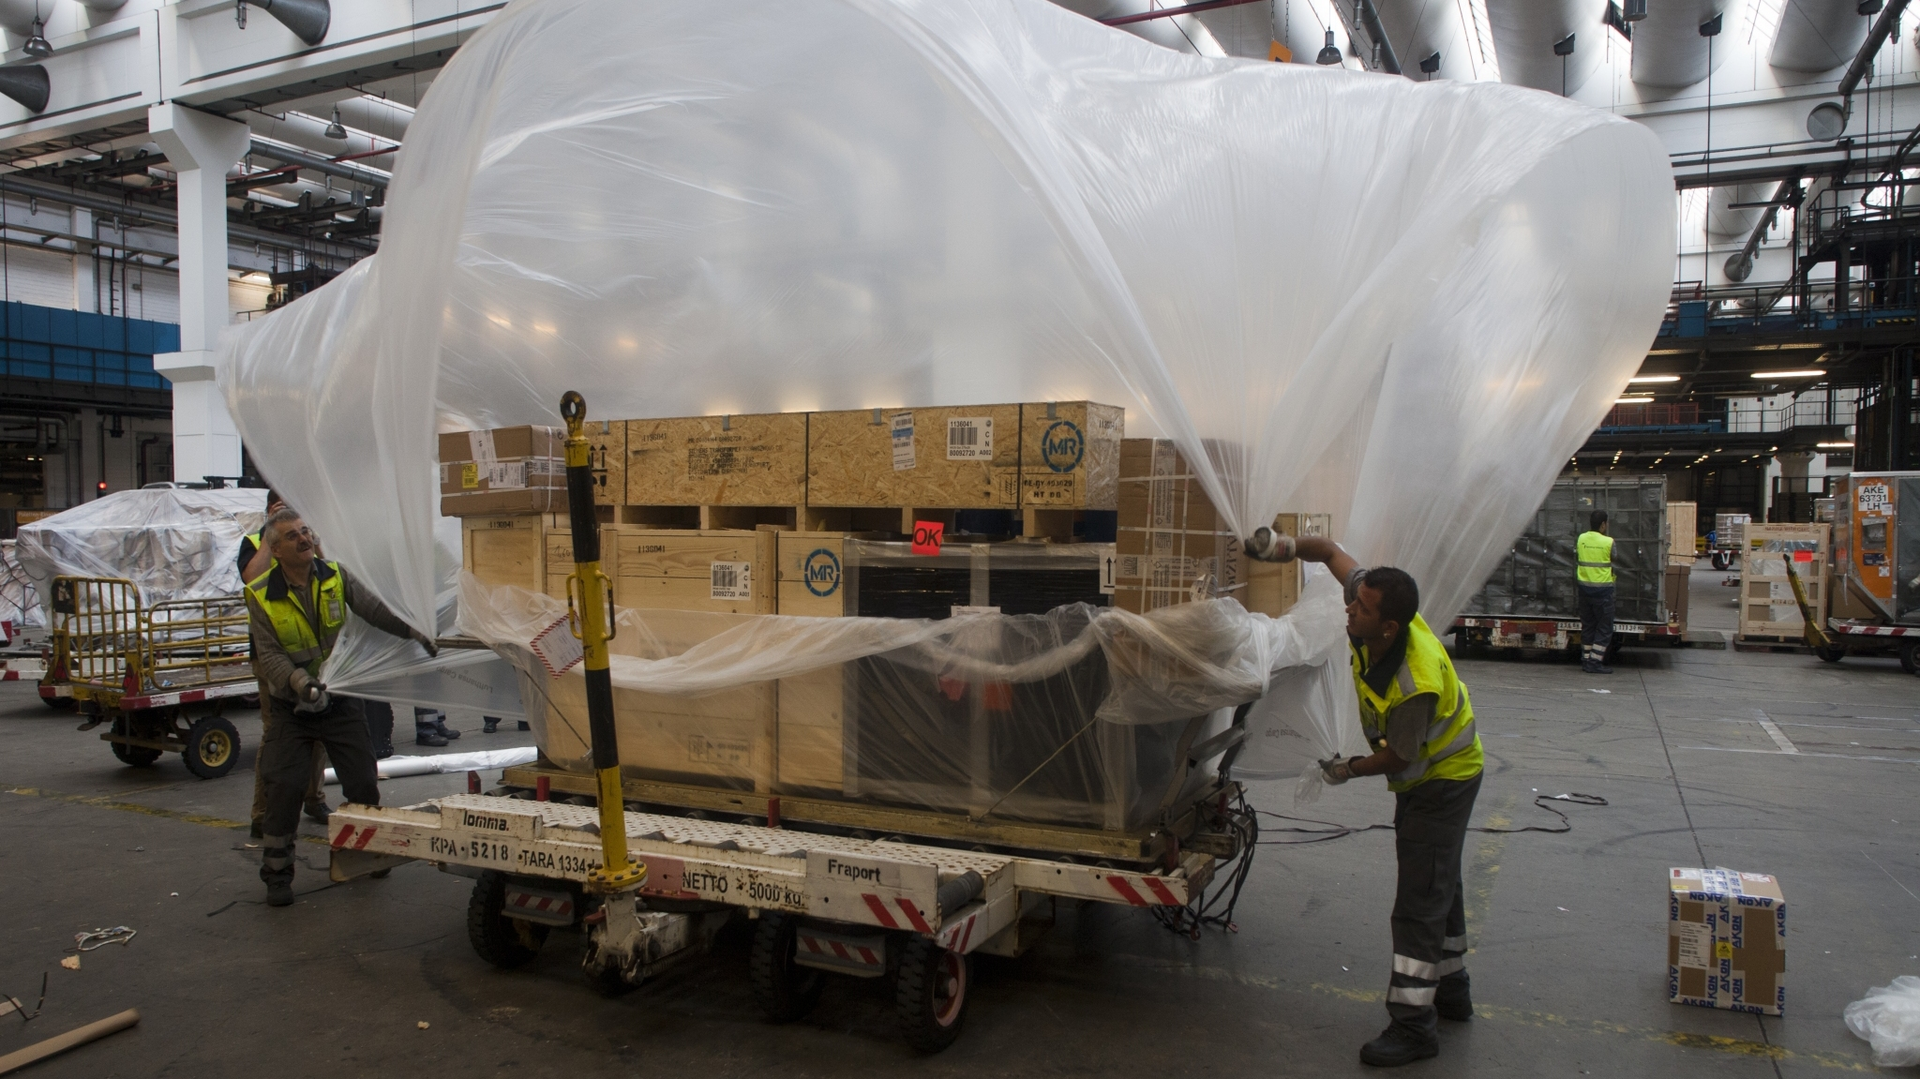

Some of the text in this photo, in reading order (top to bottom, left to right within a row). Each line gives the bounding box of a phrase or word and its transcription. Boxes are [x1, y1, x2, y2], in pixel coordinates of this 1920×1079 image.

[1049, 437, 1077, 456] MR
[1863, 486, 1885, 494] AKE
[1867, 503, 1880, 511] LH
[913, 527, 940, 547] OK
[810, 564, 835, 581] MR
[1226, 528, 1238, 594] ALIZIO
[431, 837, 457, 857] KPA
[471, 841, 509, 861] 5218
[522, 850, 555, 869] TARA
[559, 855, 586, 874] 1334
[828, 859, 881, 882] Fraport
[683, 872, 728, 893] NETTO
[749, 882, 781, 903] 5000
[1690, 892, 1724, 902] AKON
[1738, 895, 1774, 907] AKON
[1732, 915, 1742, 949] AKON
[1669, 965, 1679, 998] AKON
[1708, 975, 1718, 1000] KON
[1720, 959, 1731, 993] AKON
[1732, 978, 1742, 1002] KON
[1776, 986, 1785, 1017] KON
[1682, 997, 1714, 1008] AKON
[1730, 1003, 1764, 1014] AKON
